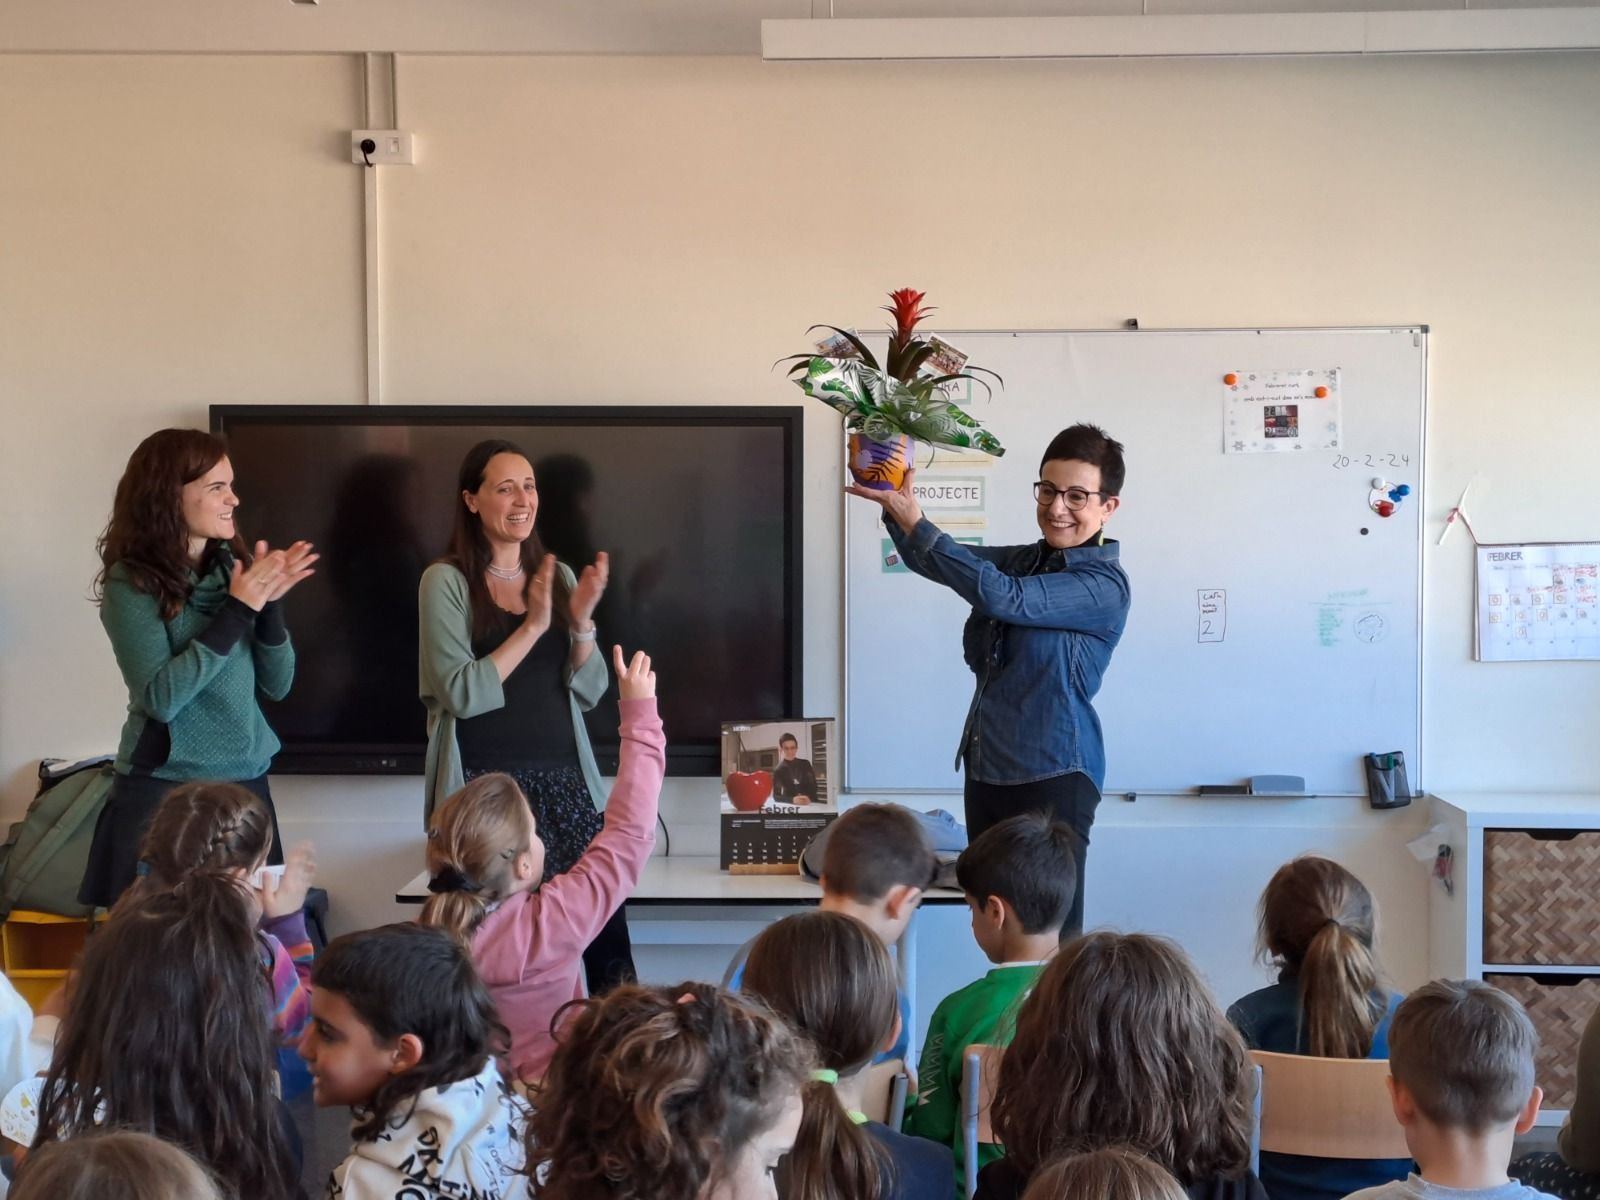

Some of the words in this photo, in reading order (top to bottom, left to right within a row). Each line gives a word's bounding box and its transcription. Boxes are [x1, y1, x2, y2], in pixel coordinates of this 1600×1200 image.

[912, 486, 979, 500] PROJECTE
[1487, 551, 1524, 561] FEBRER
[1202, 620, 1214, 635] 2
